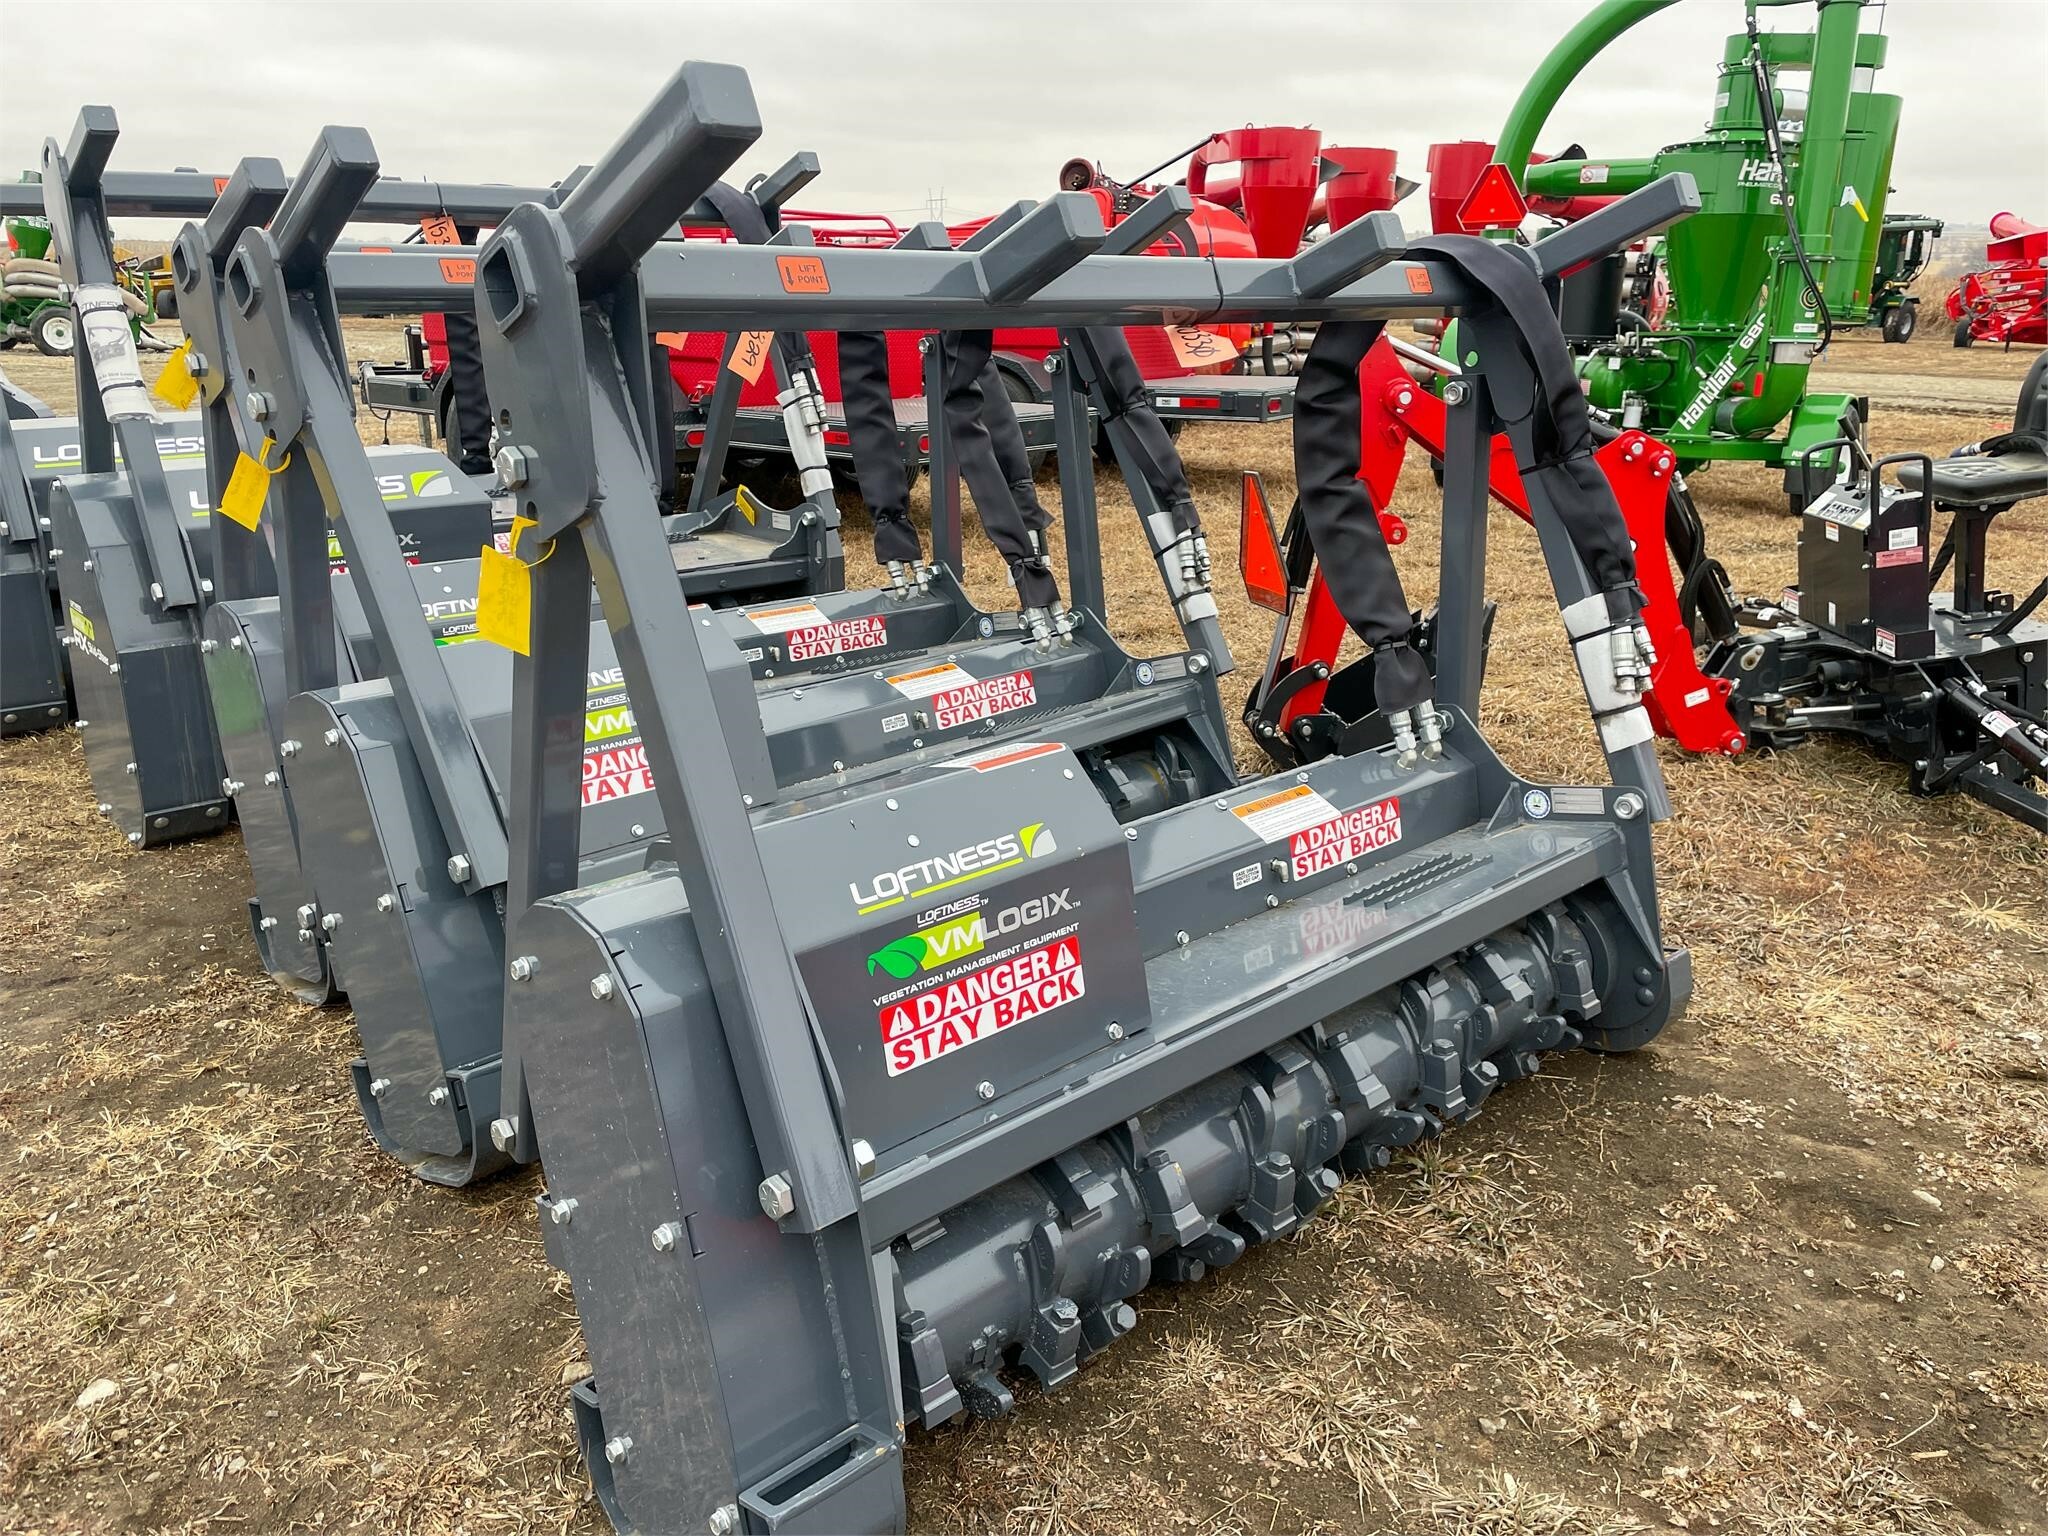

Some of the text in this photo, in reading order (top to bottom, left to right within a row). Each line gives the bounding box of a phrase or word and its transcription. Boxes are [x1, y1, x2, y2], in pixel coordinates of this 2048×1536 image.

[797, 275, 823, 284] POINT
[798, 264, 816, 273] LIFT
[793, 632, 885, 660] STAY BACK
[804, 619, 870, 643] DANGER
[939, 689, 1035, 727] STAY BACK
[950, 675, 1018, 707] DANGER
[1308, 804, 1384, 850] DANGER
[849, 833, 1020, 906] LOFTNESS
[1296, 821, 1399, 878] STAY BACK
[916, 894, 981, 925] LOFTNESS
[926, 887, 1073, 958] VMLOGIX
[873, 922, 1080, 1007] VEGETATION MANAGEMENT EQUIPMENT
[916, 950, 1052, 1027] DANGER
[891, 970, 1080, 1071] STAY BACK
